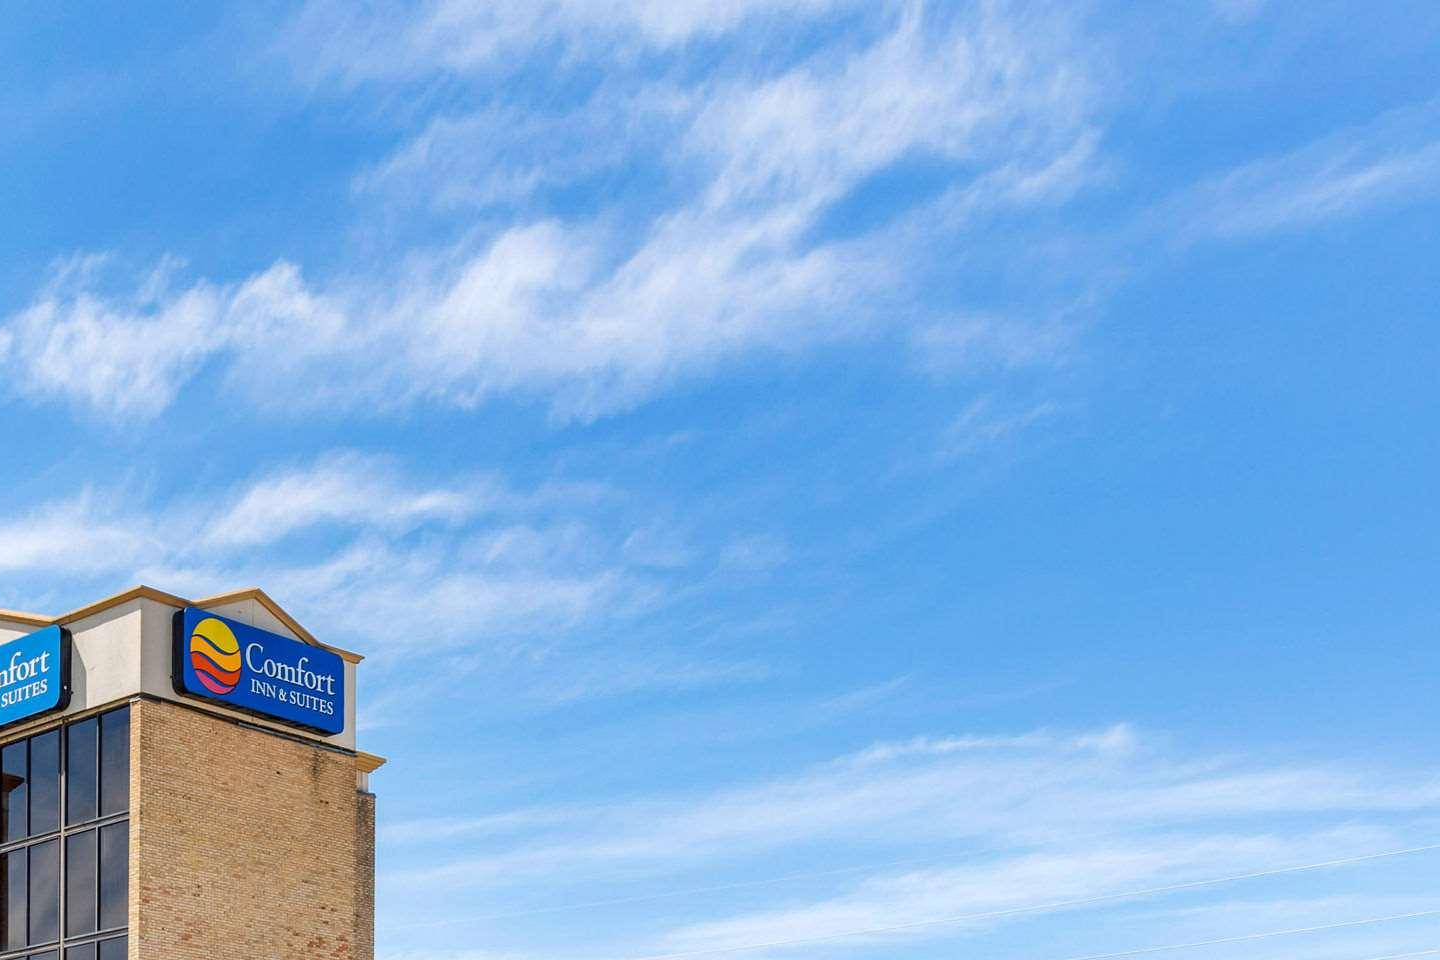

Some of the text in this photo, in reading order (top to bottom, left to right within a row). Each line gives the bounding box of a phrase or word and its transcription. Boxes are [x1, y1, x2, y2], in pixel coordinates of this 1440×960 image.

[245, 643, 337, 695] Comfort
[1, 678, 48, 708] SUITES
[250, 678, 334, 715] INN & SUITES
